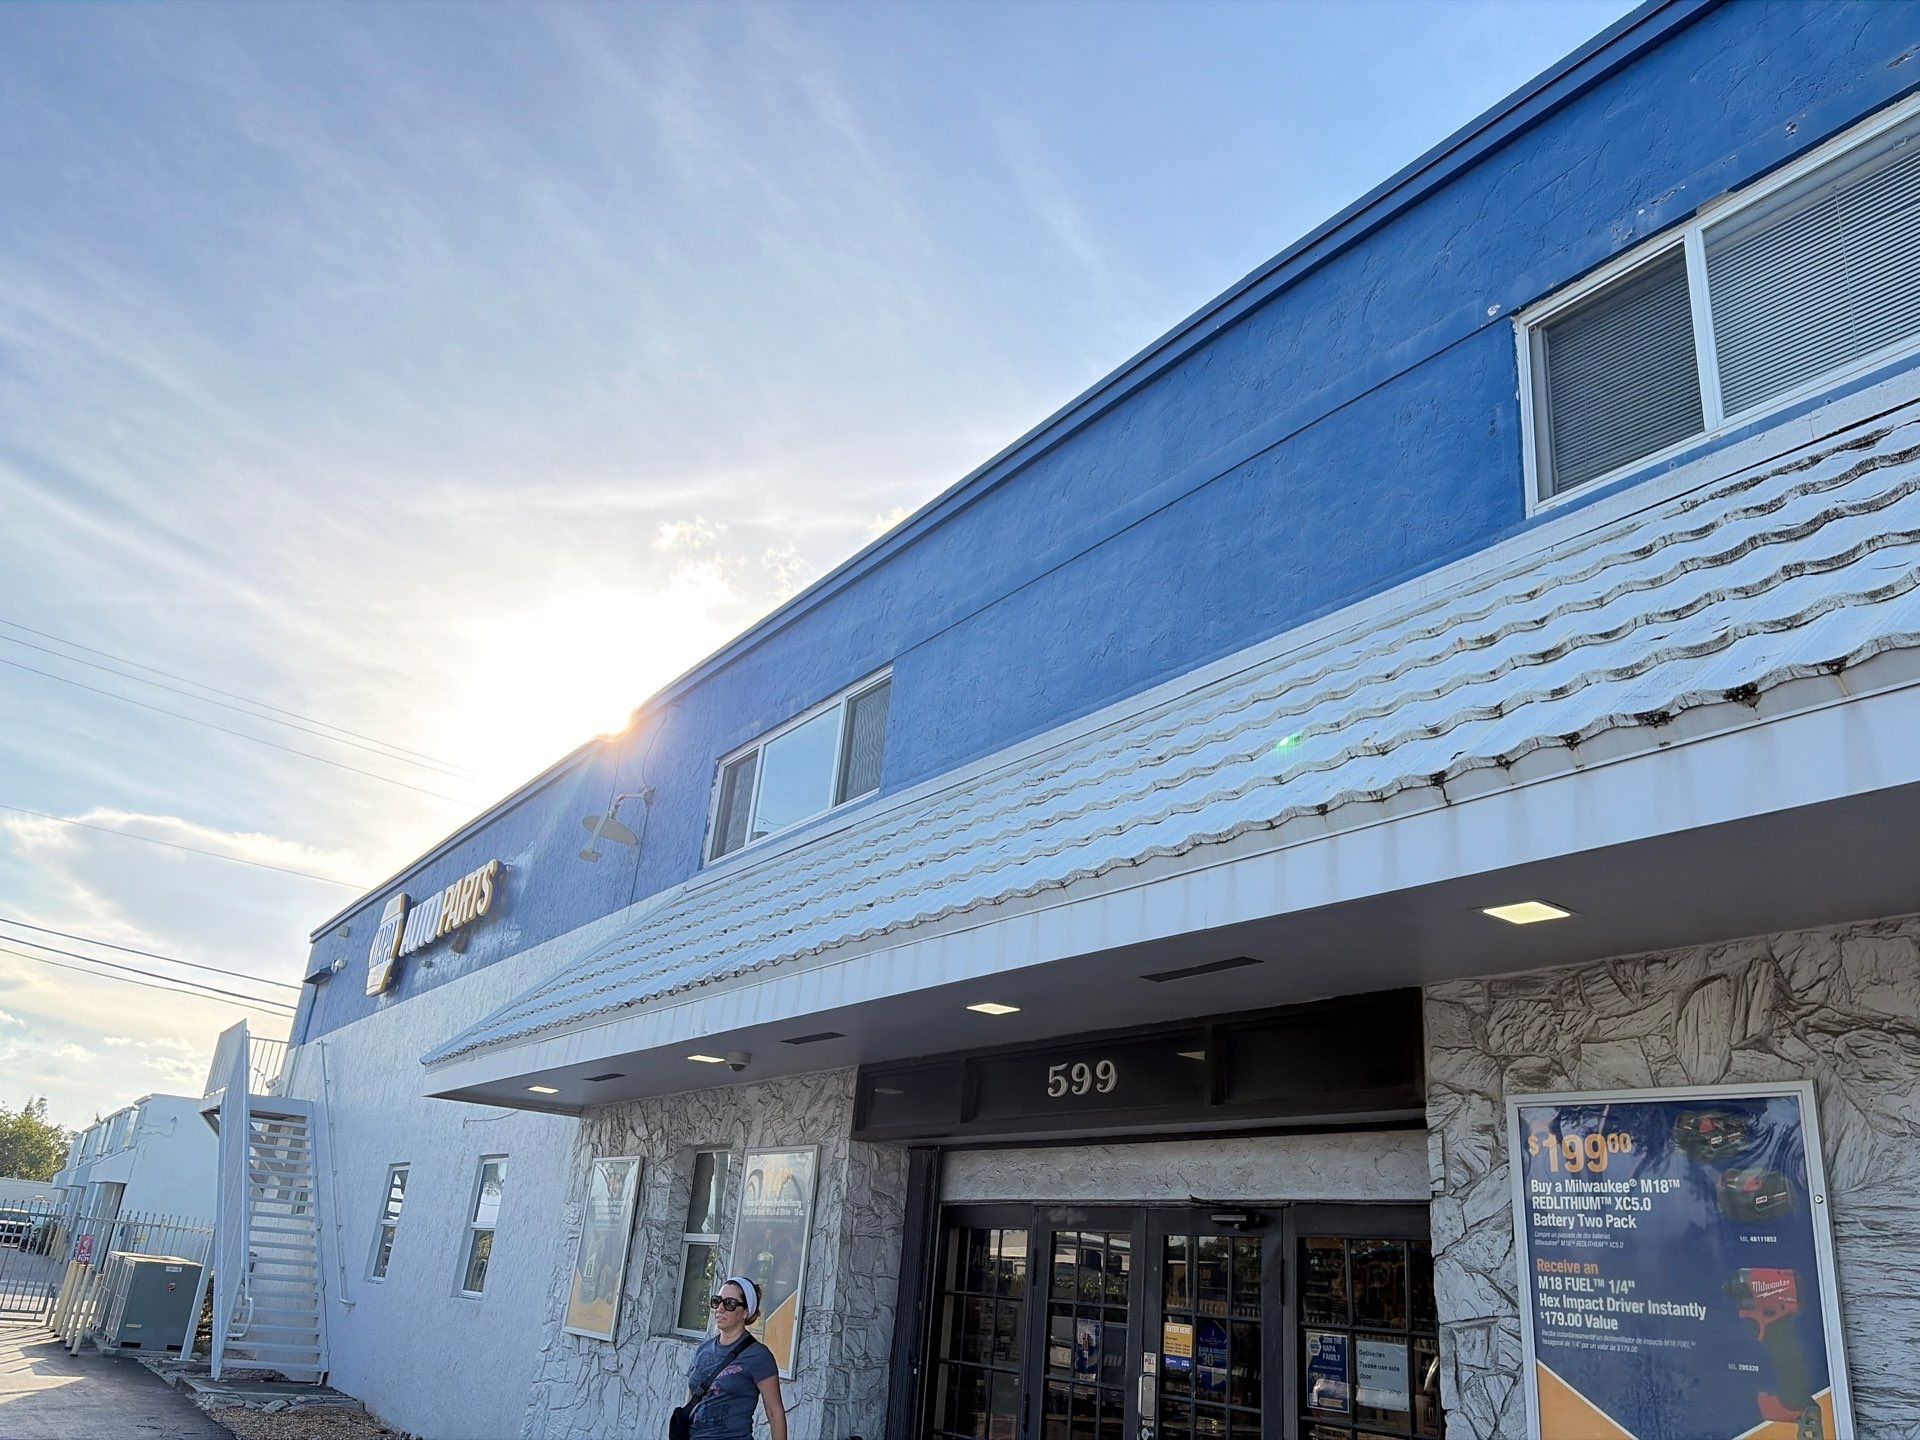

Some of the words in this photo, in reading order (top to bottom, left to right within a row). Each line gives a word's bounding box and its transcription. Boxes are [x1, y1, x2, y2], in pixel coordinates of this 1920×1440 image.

[398, 890, 445, 957] AUTO
[436, 859, 498, 937] PARTS
[1047, 1059, 1118, 1097] 599
[1530, 1179, 1552, 1195] Buy
[1555, 1182, 1563, 1193] a
[1614, 1197, 1652, 1211] XC5.0
[1533, 1213, 1575, 1229] Battery
[1577, 1213, 1603, 1228] Two
[1606, 1214, 1637, 1229] Pack
[1536, 1258, 1581, 1274] Receive
[1583, 1263, 1598, 1274] an
[1538, 1275, 1563, 1291] M18
[1751, 1279, 1791, 1293] Milwaukee
[1539, 1293, 1561, 1308] Hex
[1563, 1294, 1605, 1312] Impact
[1606, 1297, 1645, 1314] Driver
[1647, 1300, 1707, 1321] Instantly
[1540, 1311, 1582, 1327] $179.00
[1584, 1314, 1619, 1331] Value
[1166, 1325, 1180, 1333] ENTER
[1179, 1326, 1191, 1334] HERE
[1322, 1344, 1336, 1352] NAPA
[1333, 1337, 1342, 1345] THE
[1322, 1353, 1341, 1362] FAMILY
[1358, 1349, 1386, 1358] Deliveries
[1359, 1361, 1377, 1370] Please
[1378, 1363, 1388, 1371] use
[1388, 1364, 1400, 1372] side
[1359, 1372, 1372, 1380] door
